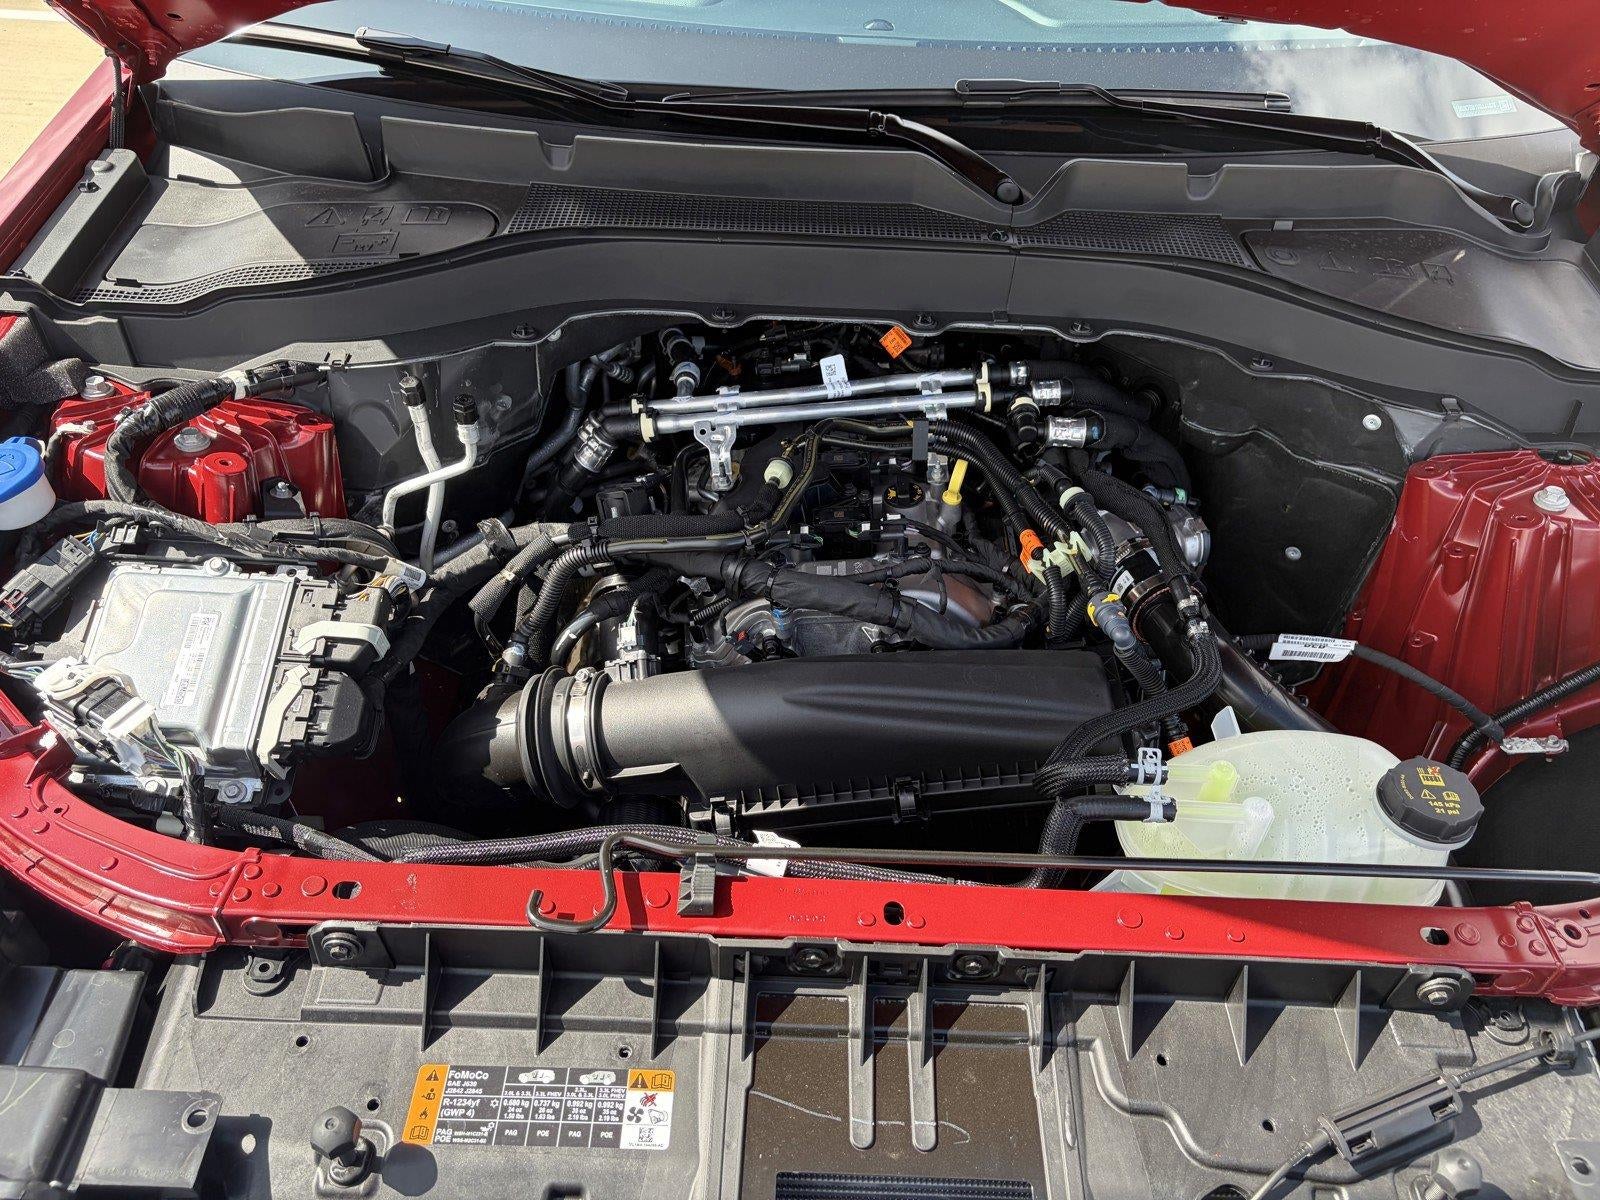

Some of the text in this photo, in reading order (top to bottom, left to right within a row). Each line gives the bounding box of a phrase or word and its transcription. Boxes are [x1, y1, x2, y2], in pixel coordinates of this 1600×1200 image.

[448, 1070, 489, 1080] FoMoCo
[443, 1098, 480, 1108] R-1234yf
[520, 1099, 530, 1108] kg
[551, 1100, 561, 1109] kg
[585, 1101, 593, 1109] kg
[597, 1101, 624, 1111] 0.992 kg
[440, 1109, 475, 1118] (GWP 4)
[434, 1135, 452, 1143] POE
[600, 1131, 614, 1139] POE
